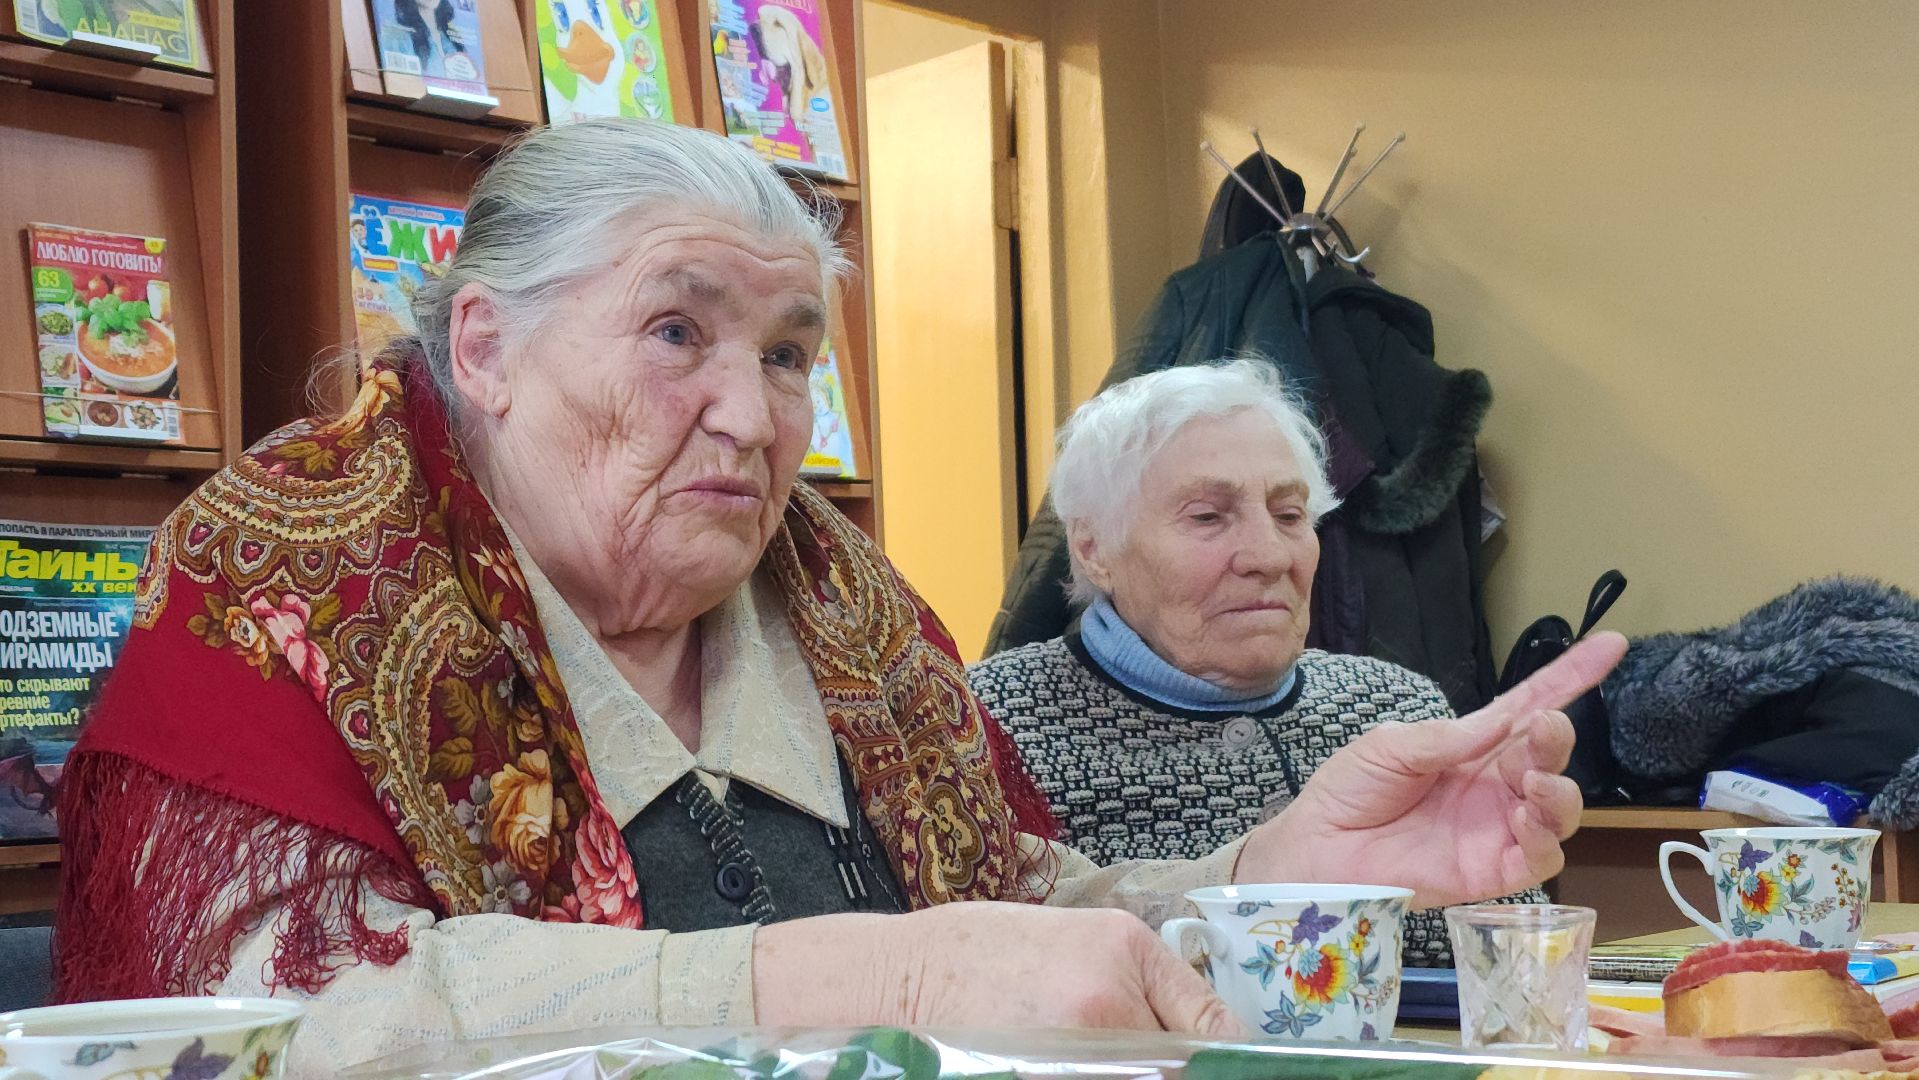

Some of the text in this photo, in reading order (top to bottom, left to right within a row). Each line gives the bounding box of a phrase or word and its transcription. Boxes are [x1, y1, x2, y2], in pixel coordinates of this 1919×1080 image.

[36, 241, 90, 265] ЛЮБЛЮ
[91, 248, 162, 274] ГОТОВИТЬ!
[37, 269, 60, 288] 63
[0, 523, 39, 535] ПОПАСТЬ
[41, 526, 47, 536] В
[48, 527, 128, 538] ПАРАЛЛЕЛЬНЫЙ
[0, 609, 120, 643] ОДЗЕМНЫЕ
[0, 642, 114, 674] ИРАМИДЫ
[16, 677, 91, 696] скрывают
[0, 707, 80, 732] ртефакты?
